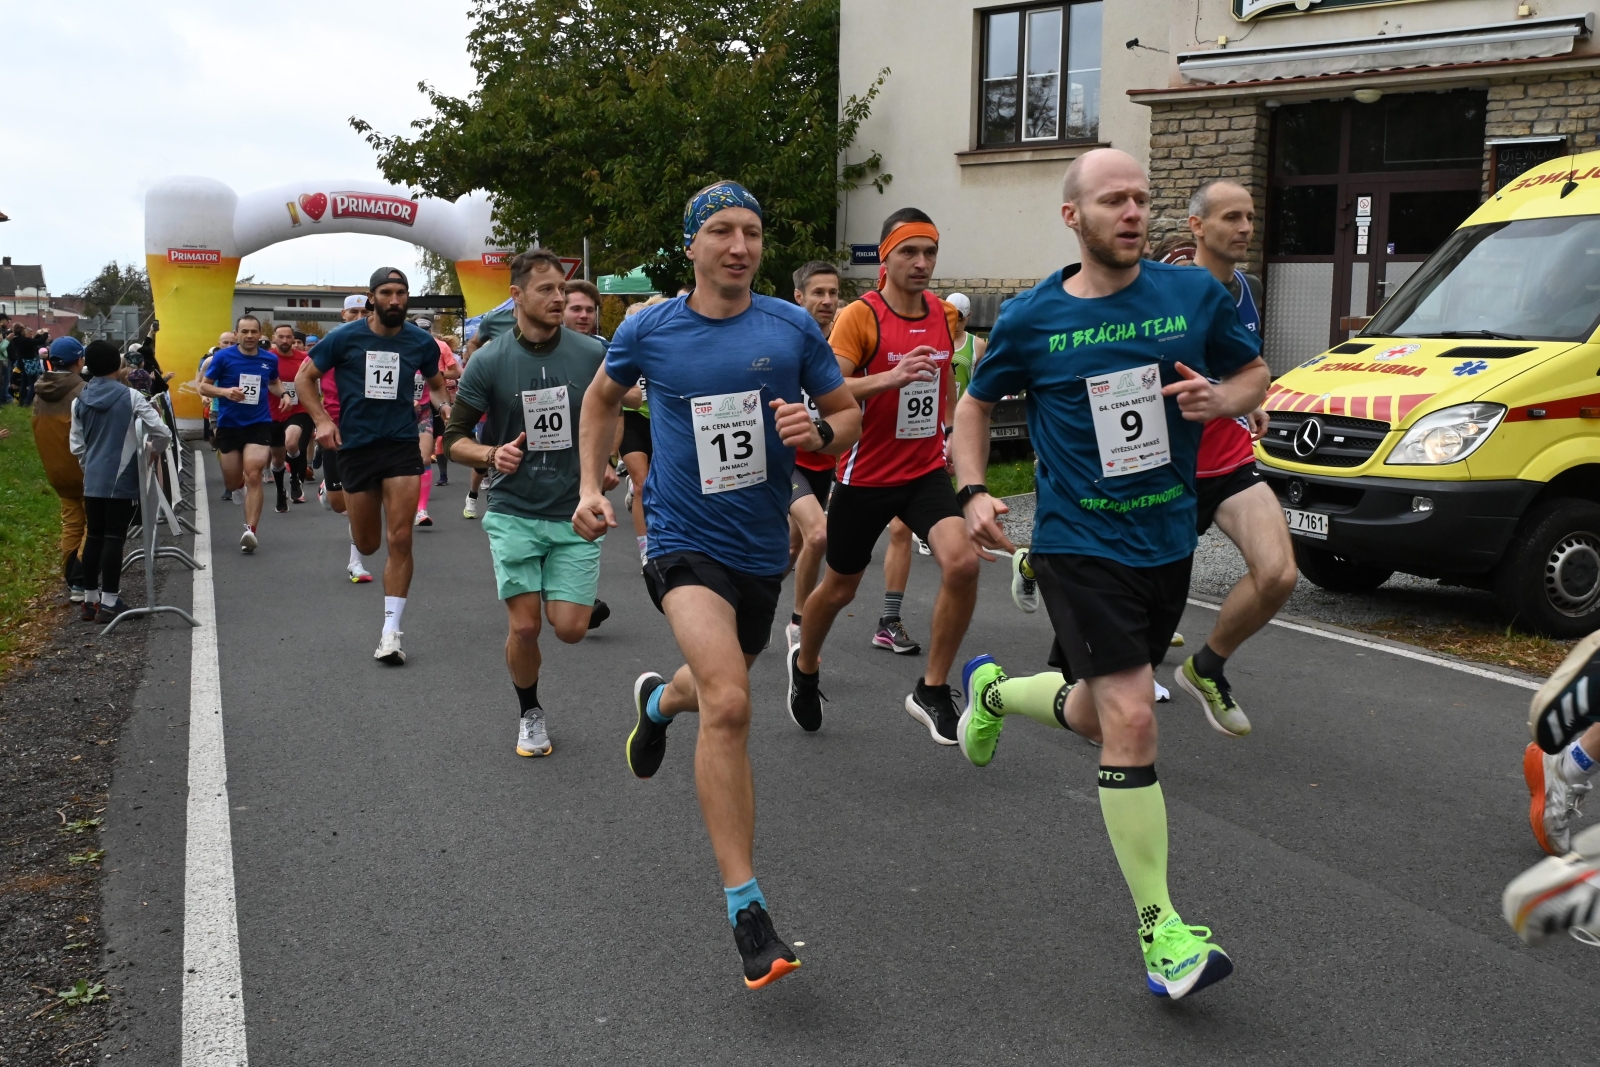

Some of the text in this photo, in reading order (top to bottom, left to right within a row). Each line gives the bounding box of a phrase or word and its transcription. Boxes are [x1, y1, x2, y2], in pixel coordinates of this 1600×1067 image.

[1048, 333, 1067, 353] DJ
[1072, 322, 1136, 348] BRÁCHA
[1141, 315, 1187, 337] TEAM
[373, 370, 393, 384] 14
[244, 386, 256, 395] 25
[1091, 385, 1110, 394] CUP
[695, 406, 712, 414] CUP
[908, 396, 933, 418] 98
[1111, 401, 1130, 410] CENA
[1132, 395, 1157, 405] METUJE
[534, 412, 562, 432] 40
[712, 422, 730, 430] CENA
[732, 419, 757, 427] METUJE
[1120, 410, 1143, 442] 9
[710, 430, 753, 462] 13
[1111, 438, 1160, 454] VÍTĚZSLAV MIKEŠ
[1299, 513, 1322, 531] 7161
